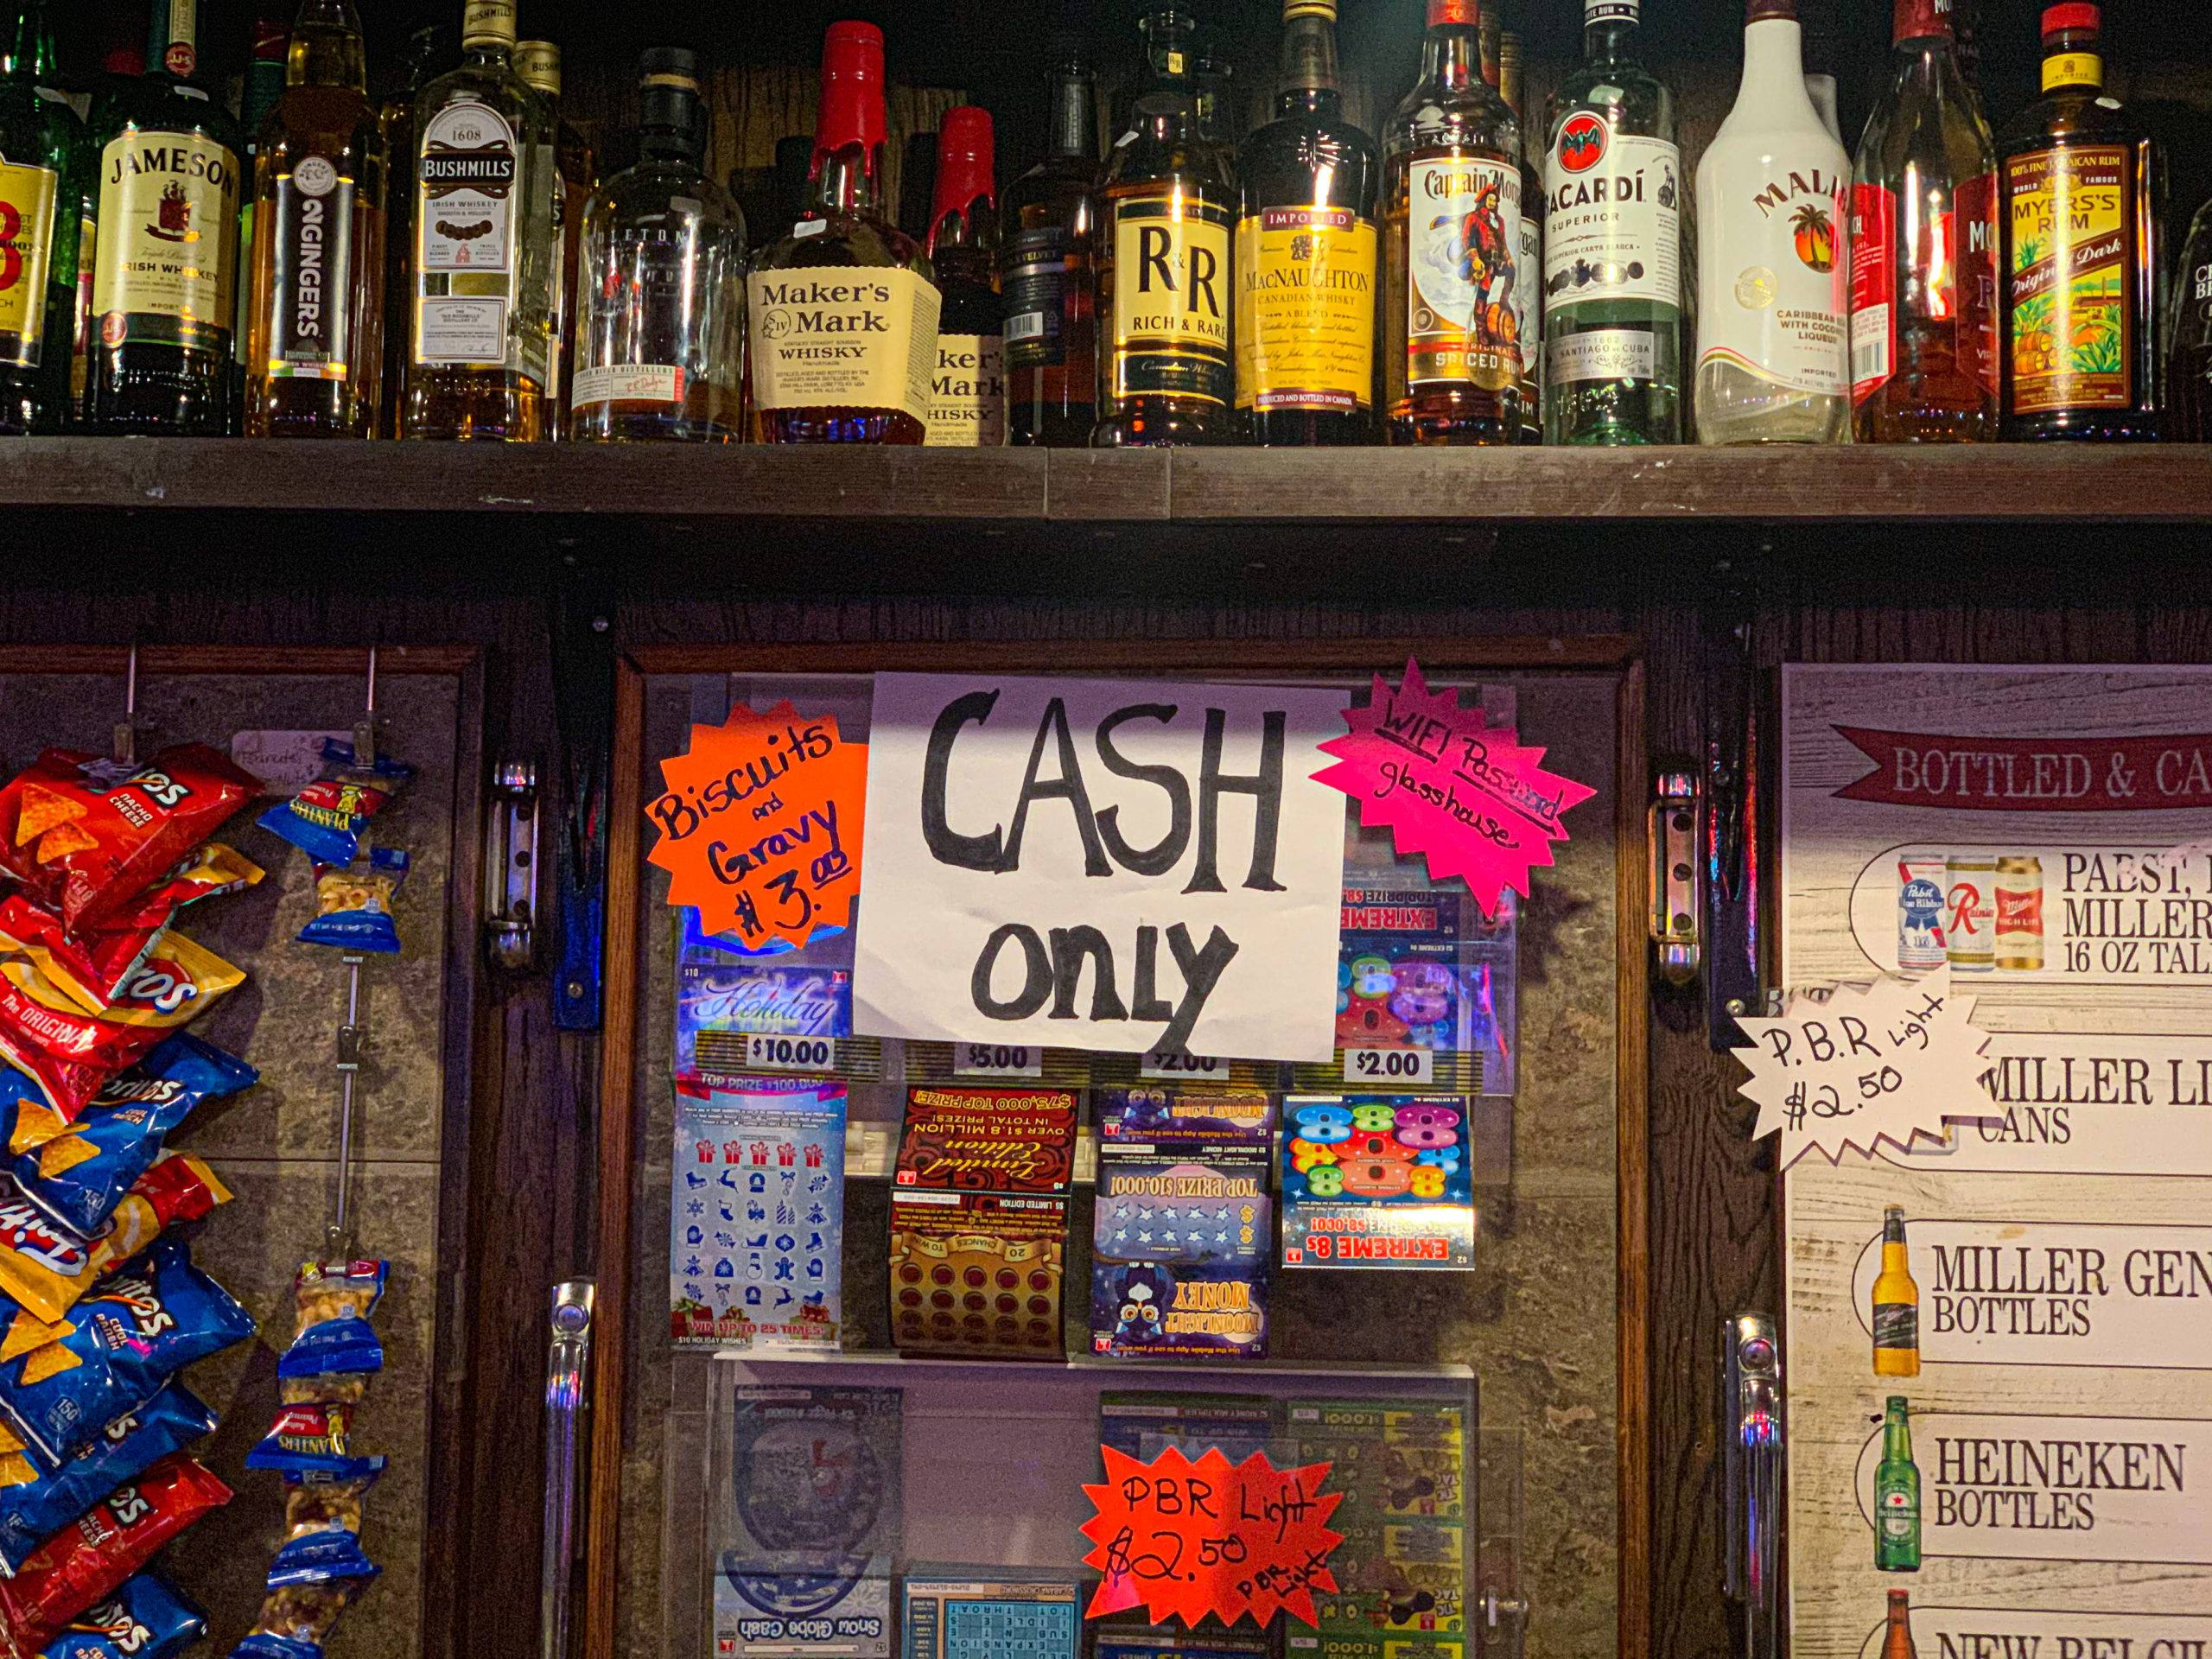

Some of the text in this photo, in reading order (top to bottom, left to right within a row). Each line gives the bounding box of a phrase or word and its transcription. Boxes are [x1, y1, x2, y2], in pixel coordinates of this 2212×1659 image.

[468, 8, 512, 25] BUSHMILLS
[1599, 6, 1614, 15] RUM
[452, 130, 482, 142] 1608
[111, 148, 234, 198] JAMESON
[425, 161, 512, 178] BUSHMILLS
[2030, 162, 2046, 173] FINE
[2100, 156, 2120, 166] RUM
[1269, 214, 1347, 225] IMPORTED
[1552, 212, 1620, 234] SUPERIOR
[2076, 238, 2122, 266] Dark
[761, 283, 890, 306] Maker's
[1258, 295, 1355, 305] CANADIAN WHISKY
[794, 311, 887, 334] Mark
[1134, 316, 1226, 340] RICH & RARE
[1777, 309, 1835, 324] CARIBBEAN
[1780, 321, 1808, 329] WITH
[779, 346, 868, 359] WHISKY
[1436, 353, 1498, 370] SPICED
[1560, 345, 1649, 359] SANTIAGO CUBA
[1802, 368, 1837, 378] IMPORTED
[1385, 698, 1565, 821] WIFI Password
[654, 725, 833, 841] Biscuits
[1894, 747, 2092, 798] BOTTLED
[2105, 752, 2136, 798] &
[919, 687, 1287, 895] CASH
[108, 797, 145, 828] CHEESE
[119, 792, 154, 823] NACHO
[752, 791, 784, 822] and
[1374, 761, 1521, 849] glasshouse
[708, 800, 841, 885] Gravy
[2063, 853, 2193, 899] PABST,
[1907, 884, 1934, 898] Pabst
[2063, 898, 2212, 939] MILLER
[2064, 941, 2092, 972] 16
[2101, 941, 2139, 973] OZ
[684, 968, 699, 977] $10
[1, 994, 21, 1015] The
[695, 977, 836, 1036] Holiday
[1888, 992, 1944, 1051] Light
[753, 1038, 830, 1065] $10.00
[968, 1046, 1028, 1071] $5.00
[1357, 1051, 1420, 1077] $2.00
[702, 1073, 725, 1087] TOP
[728, 1077, 763, 1090] PRIZE
[913, 1090, 1071, 1110] $75,000 TOP PRIZE!
[1783, 1065, 1903, 1132] $2.50
[913, 1122, 1065, 1135] OVER $1.8 MILLION
[931, 1114, 984, 1123] PRIZES!
[988, 1116, 1030, 1125] TOTAL
[1977, 1106, 2072, 1145] CANS
[944, 1140, 1041, 1160] Edition
[921, 1157, 1046, 1180] Limited
[1109, 1175, 1258, 1198] TOP PRIZE $10,000!
[999, 1199, 1052, 1209] LIMITED EDITION
[1310, 1217, 1367, 1233] $8,000!
[956, 1238, 997, 1249] CHANCES
[1009, 1249, 1026, 1257] 20
[1306, 1235, 1450, 1261] EXTREME 8s
[1931, 1245, 2110, 1297] MILLER
[1171, 1281, 1251, 1311] MONEY
[1164, 1312, 1259, 1335] MOONLIGHT
[1932, 1295, 2091, 1337] BOTTLES
[95, 1313, 121, 1351] RANCH
[108, 1317, 130, 1347] COOL
[690, 1320, 826, 1336] WIN UP TO 25 TIMES!
[678, 1336, 747, 1346] $10 HOLIDAY WISHES
[57, 1397, 79, 1420] 150
[1934, 1437, 2187, 1492] HEINEKEN
[1122, 1476, 1318, 1544] PBR Light
[1934, 1489, 2095, 1531] BOTTLES
[1103, 1526, 1248, 1588] $2.50
[1236, 1563, 1289, 1600] PBR
[737, 1617, 880, 1642] Snow Globe Cash
